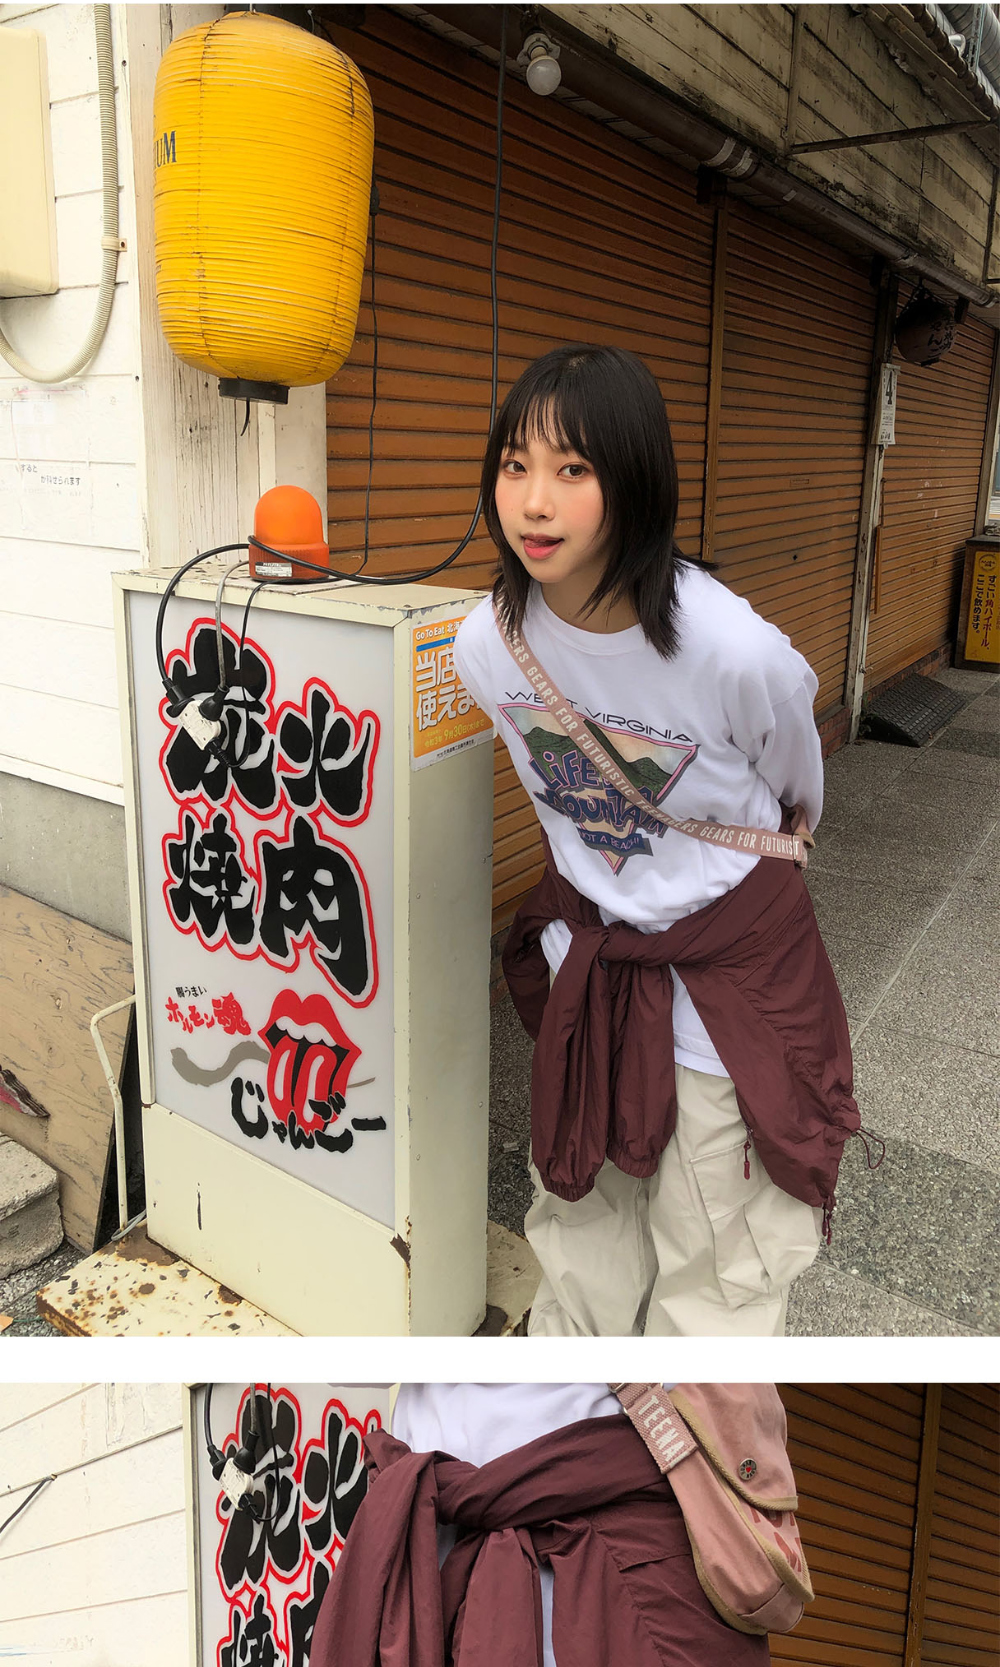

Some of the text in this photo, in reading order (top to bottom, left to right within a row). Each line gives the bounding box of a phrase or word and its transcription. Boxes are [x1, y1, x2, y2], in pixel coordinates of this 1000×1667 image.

[415, 621, 462, 641] Go To Eat 北海
[160, 620, 379, 825] 炭火
[416, 684, 482, 732] 使えま
[505, 691, 694, 743] WET VIRGINIA
[526, 666, 558, 706] GEARS
[555, 707, 578, 733] FOR
[576, 733, 635, 797] FUTURISTIC
[699, 826, 735, 844] GEARS
[737, 832, 757, 849] FOR
[164, 810, 377, 1005] 焼肉
[165, 991, 252, 1035] ホルモン魂
[216, 1385, 382, 1599] 炭火
